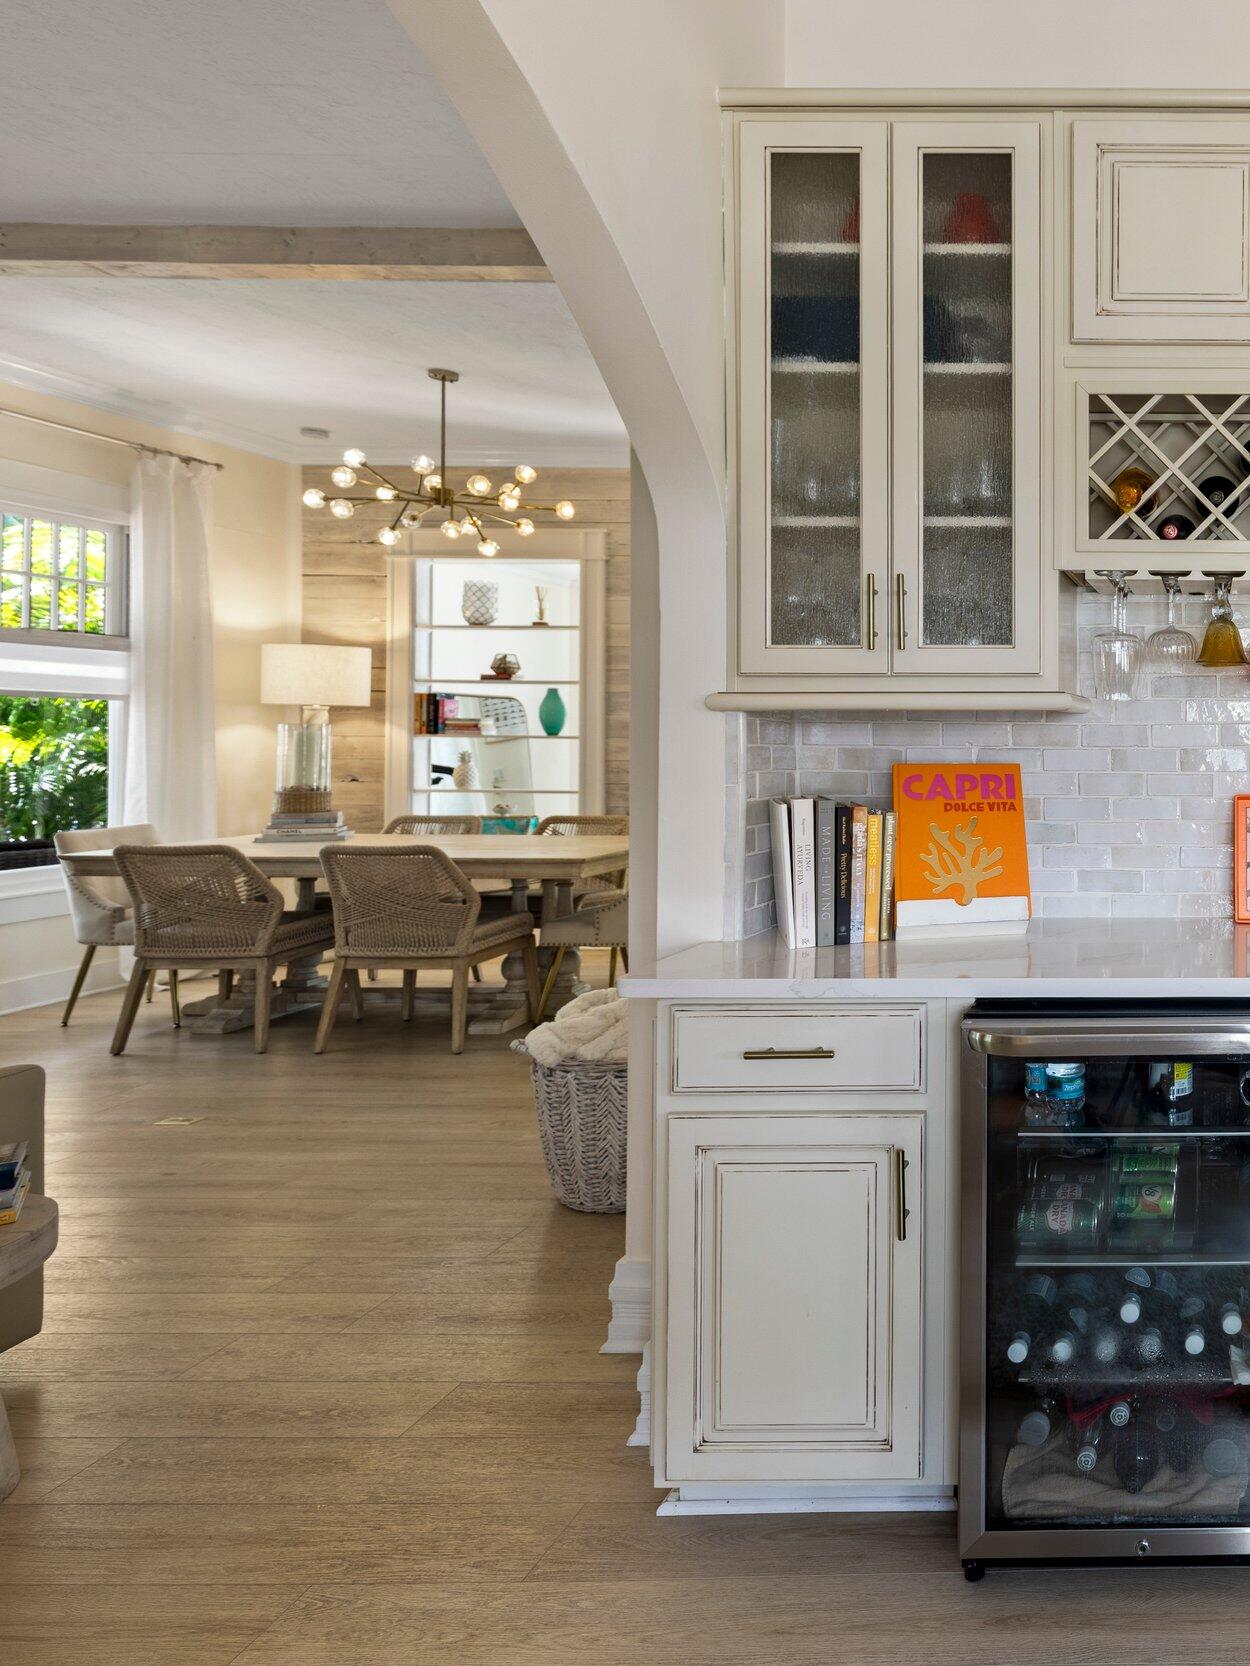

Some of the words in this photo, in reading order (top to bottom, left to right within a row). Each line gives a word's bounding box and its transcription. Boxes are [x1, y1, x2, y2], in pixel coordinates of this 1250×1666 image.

[902, 773, 1016, 801] CAPRI
[944, 802, 985, 812] DOLCE
[987, 801, 1018, 812] VITA
[887, 815, 895, 835] plant
[804, 844, 812, 872] LIVING
[822, 826, 831, 862] MADE
[870, 818, 878, 866] meatless
[884, 853, 892, 890] processed
[822, 875, 831, 920] LIVING
[1144, 1185, 1160, 1197] V8
[1057, 1199, 1069, 1235] ANADA
